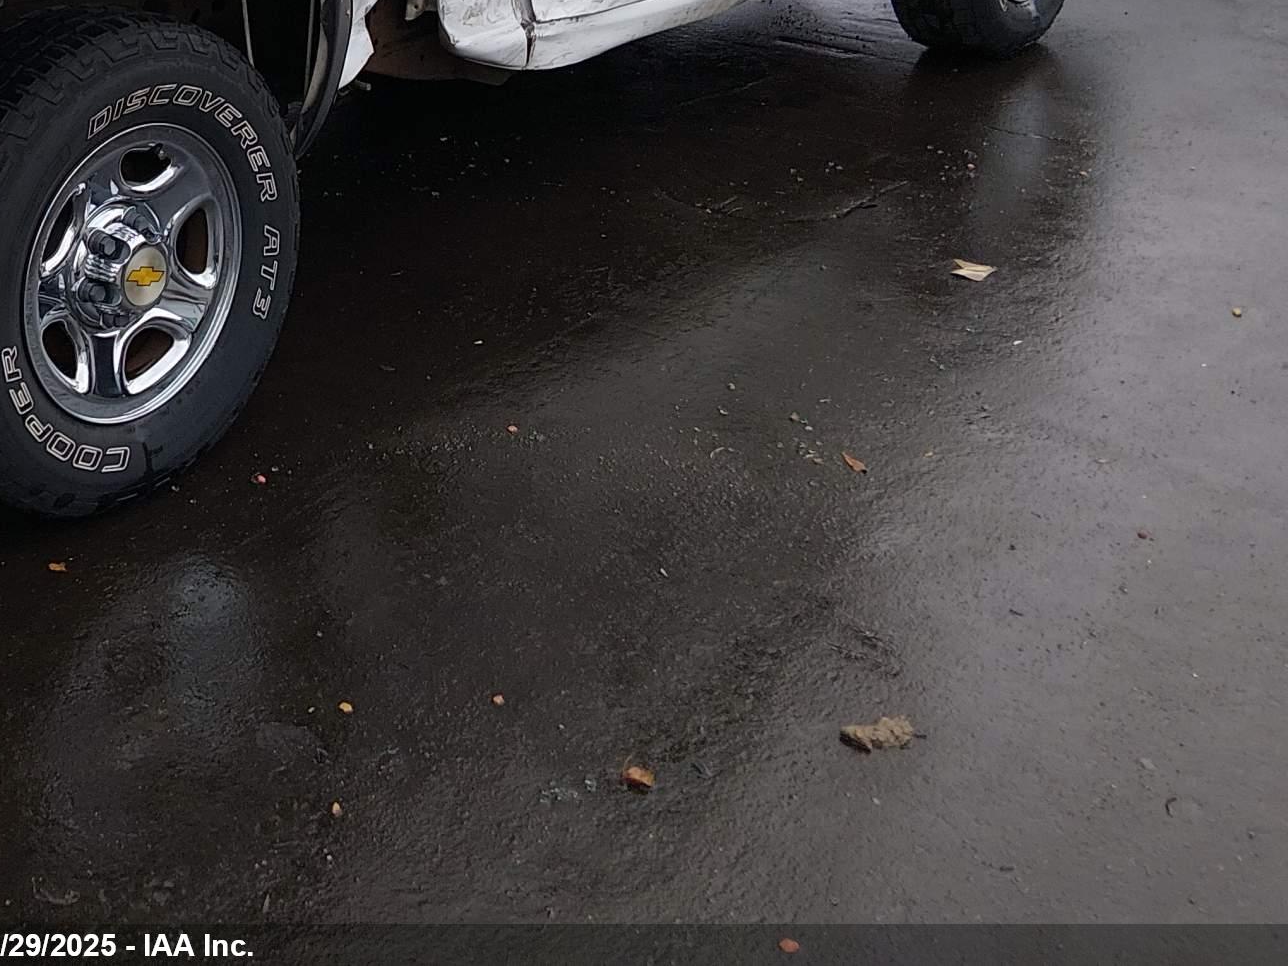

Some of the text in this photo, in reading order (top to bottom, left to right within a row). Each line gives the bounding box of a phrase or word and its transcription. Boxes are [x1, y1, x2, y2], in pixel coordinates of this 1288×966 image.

[86, 82, 281, 322] DISCOVERER AT3
[0, 345, 130, 474] COOPER
